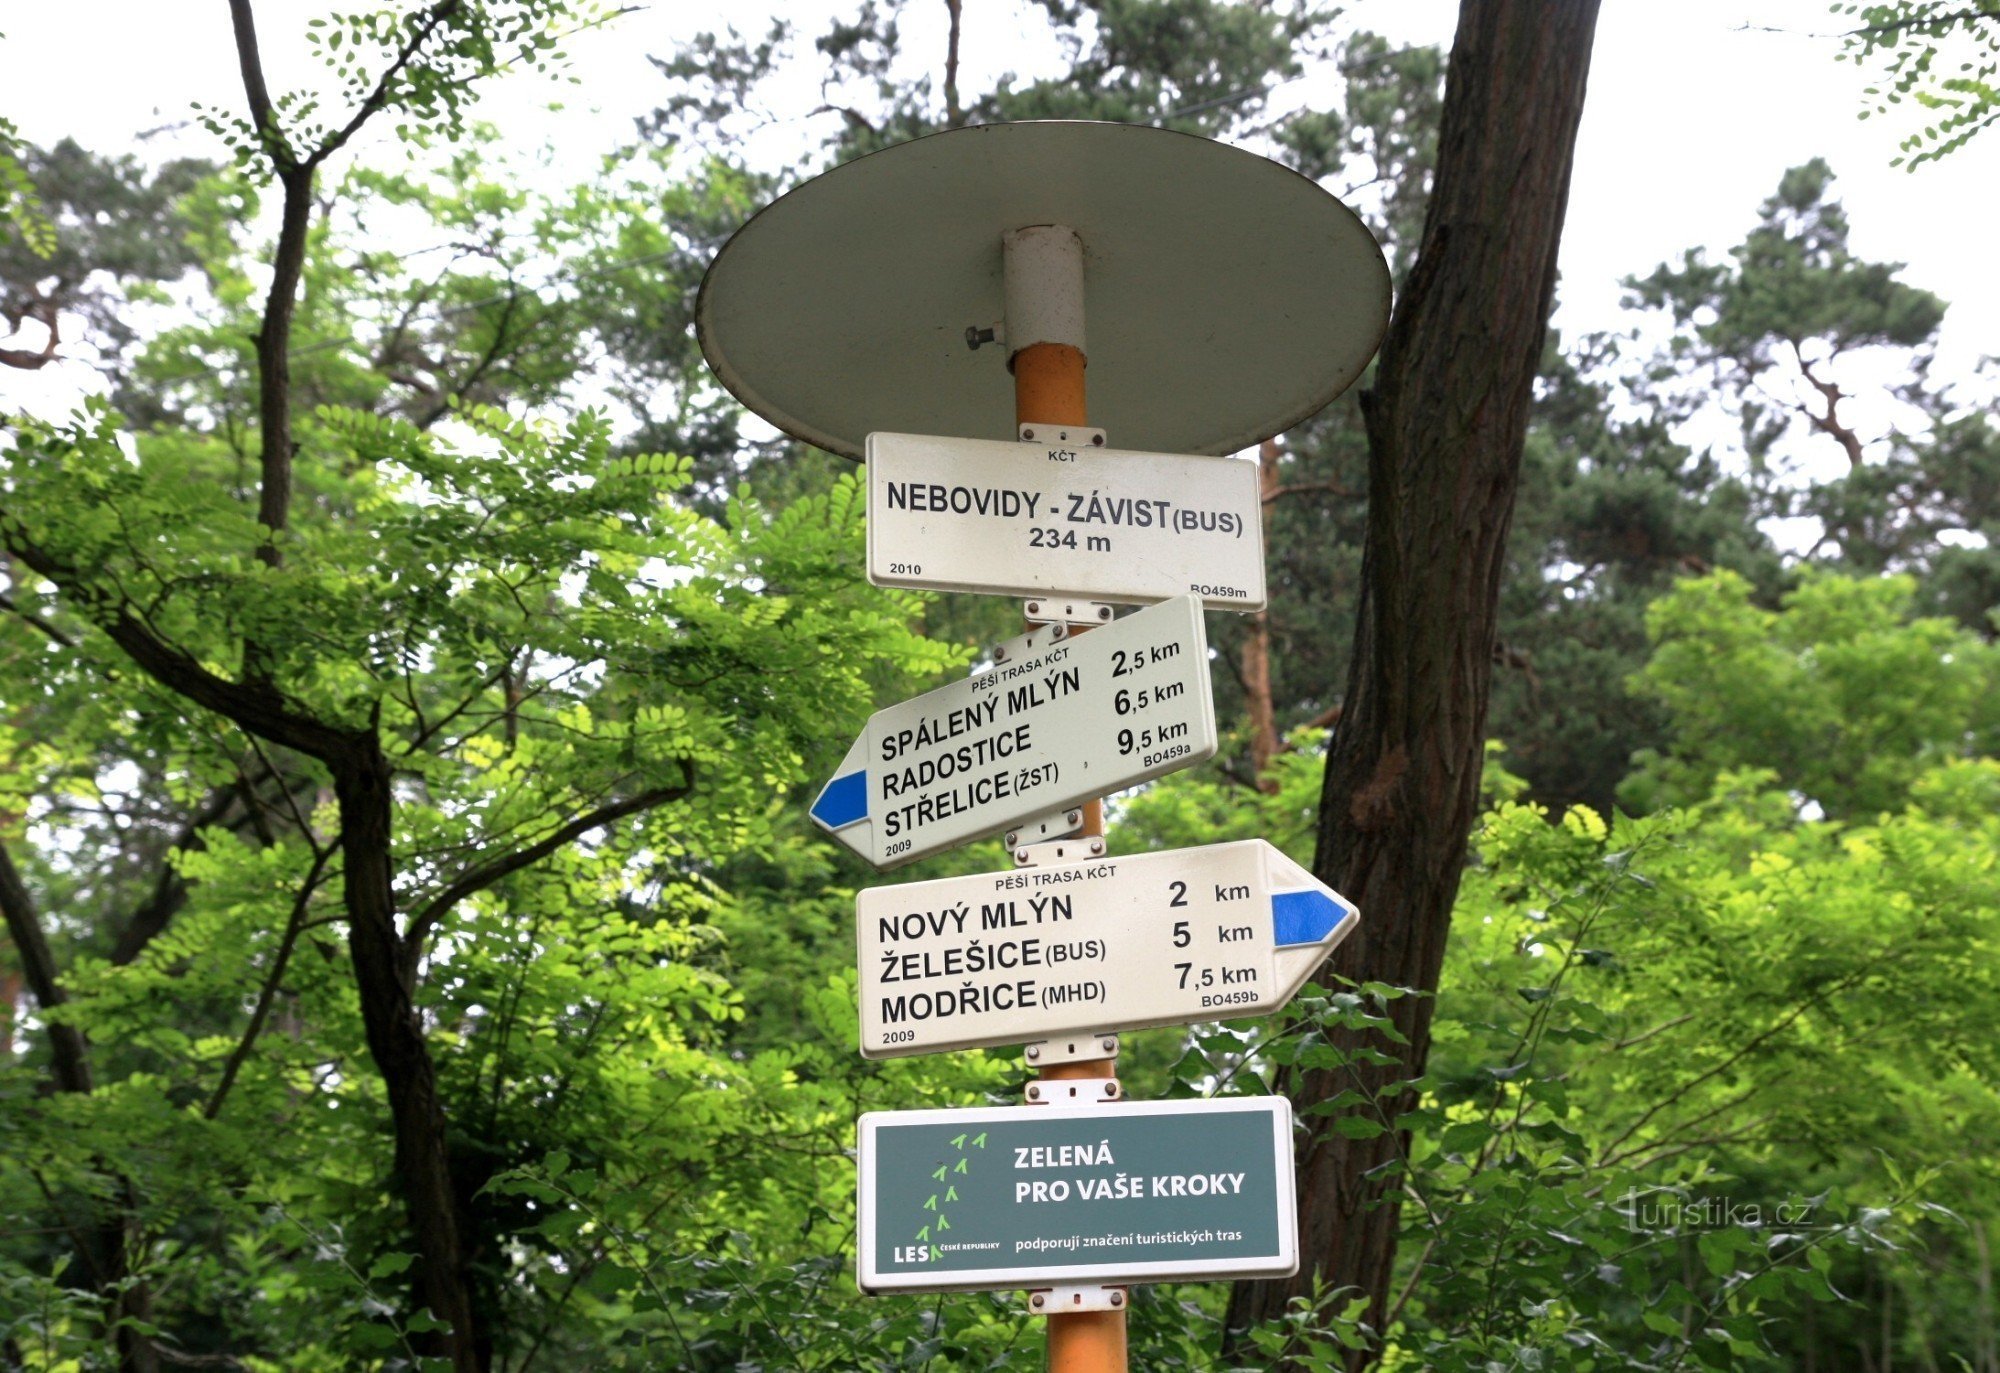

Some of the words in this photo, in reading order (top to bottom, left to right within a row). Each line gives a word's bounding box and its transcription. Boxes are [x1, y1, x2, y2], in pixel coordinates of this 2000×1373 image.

[1048, 450, 1077, 462] KČT
[887, 482, 1041, 519] NEBOVIDY
[1029, 528, 1078, 550] 234
[1087, 535, 1111, 552] m
[890, 563, 922, 575] 2010
[1190, 584, 1247, 598] BO459m
[972, 673, 999, 693] PĚŠÍ
[1000, 658, 1042, 682] TRASA
[1045, 647, 1070, 668] KČT
[882, 694, 999, 761] SPÁLENÝ
[1008, 667, 1080, 716] MLÝN
[1111, 650, 1144, 678] 2,5
[1150, 641, 1180, 663] km
[883, 725, 1032, 800] RADOSTICE
[1114, 688, 1149, 716] 6,5
[1155, 679, 1185, 703] km
[1117, 728, 1151, 755] 9,5
[1158, 720, 1188, 743] km
[1144, 745, 1191, 767] BO459a
[885, 839, 912, 857] 2009
[995, 874, 1029, 890] PĚŠÍ
[1033, 869, 1084, 885] TRASA
[1087, 864, 1117, 880] KČT
[879, 901, 970, 943] NOVÝ
[982, 894, 1072, 930] MLÝN
[1169, 881, 1188, 908] 2
[1215, 884, 1250, 902] km
[1173, 922, 1191, 948] 5
[1218, 925, 1253, 943] km
[1174, 963, 1214, 992] 7,5
[1222, 965, 1257, 985] km
[1201, 991, 1259, 1008] BO459b
[882, 1030, 915, 1044] 2009
[1014, 1139, 1114, 1168] ZELENÁ
[1016, 1180, 1069, 1203] PRO
[1076, 1173, 1144, 1200] VAŠE
[1152, 1173, 1245, 1196] KROKY
[940, 1242, 961, 1251] ČESKÉ
[963, 1242, 1000, 1251] REPUBLIKY
[1016, 1234, 1079, 1253] podporují
[1083, 1231, 1134, 1247] značení
[1137, 1229, 1213, 1246] turistických
[1216, 1229, 1242, 1241] tras
